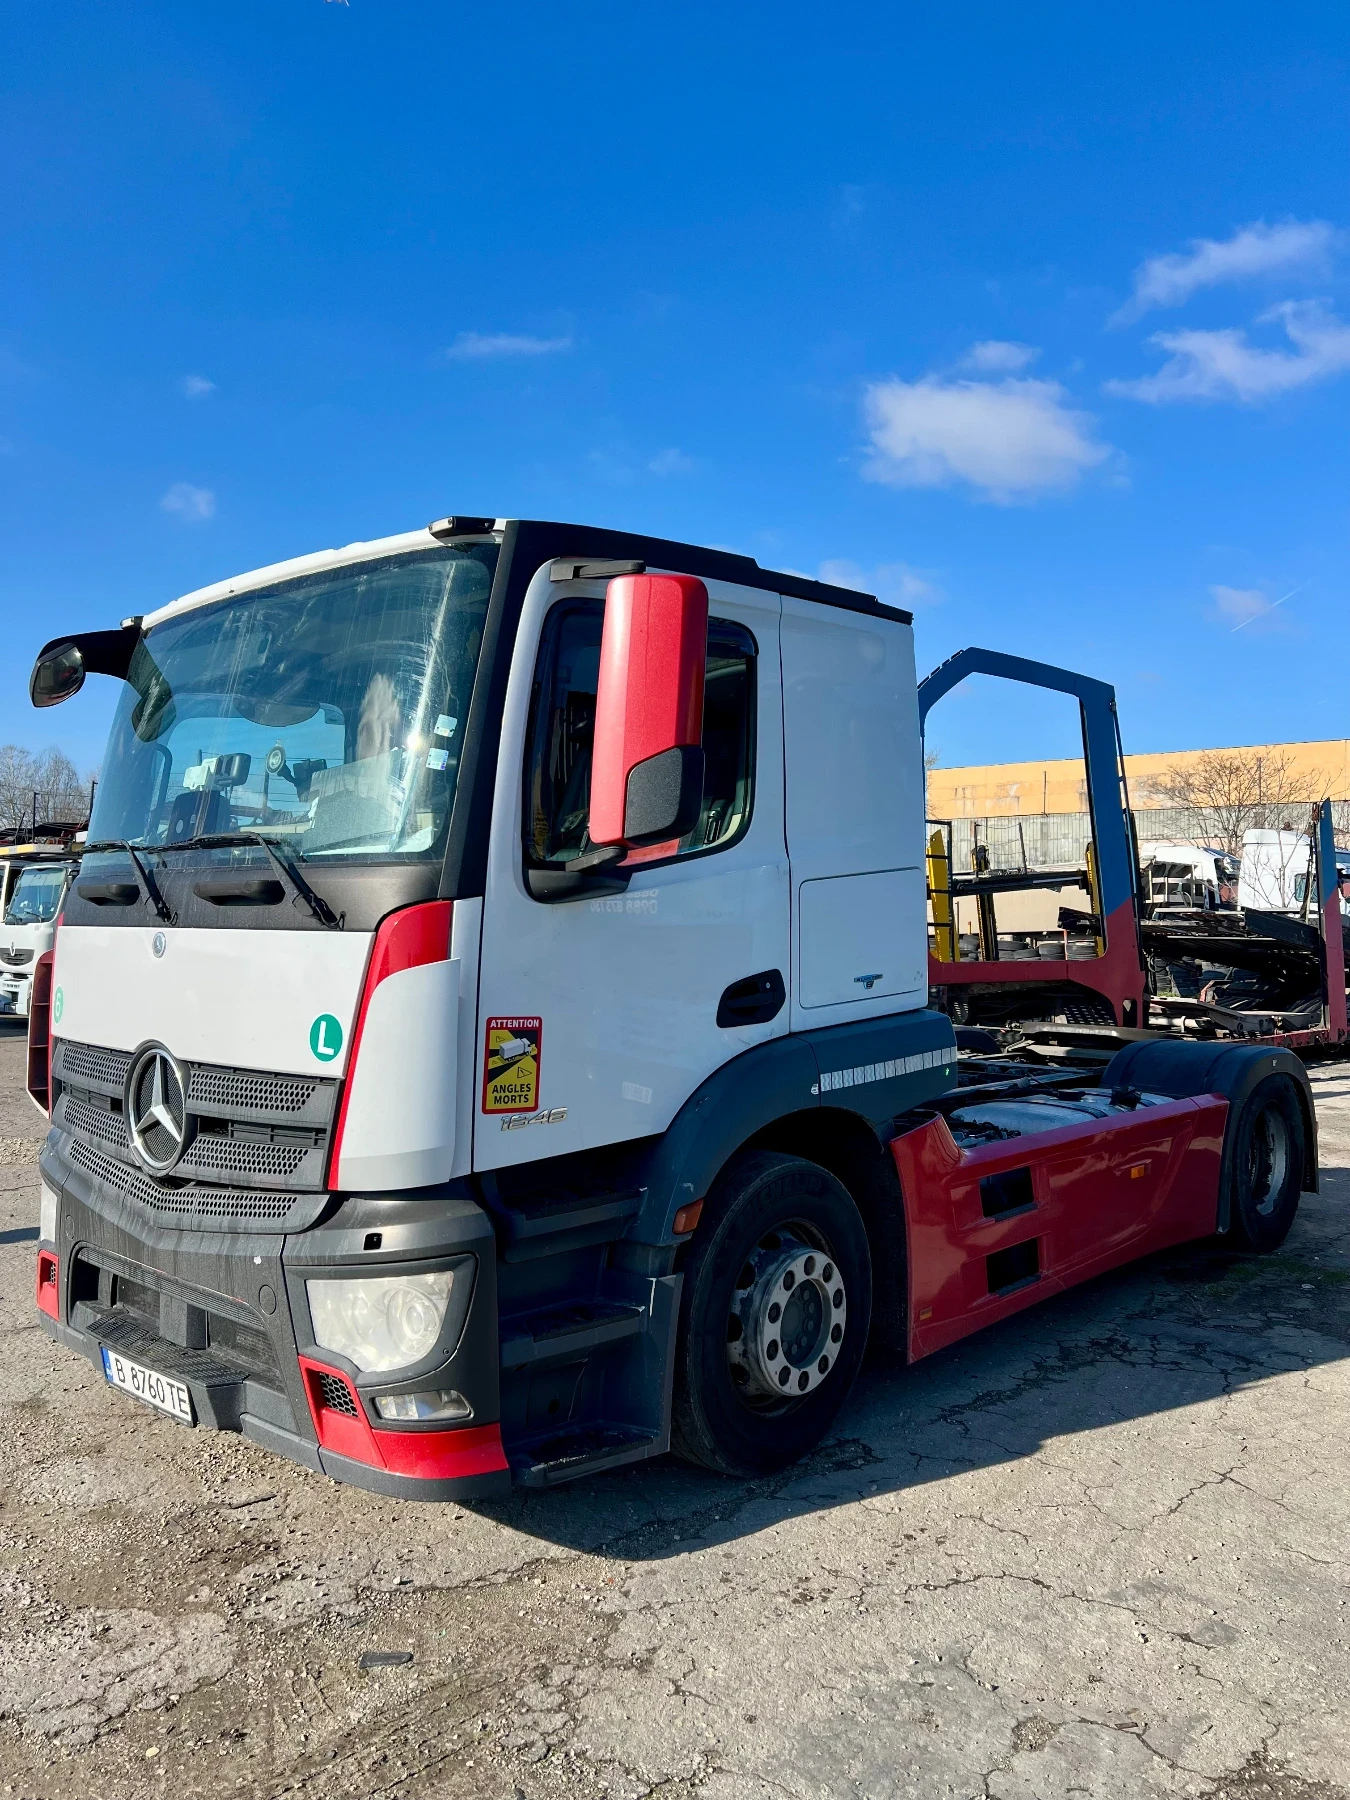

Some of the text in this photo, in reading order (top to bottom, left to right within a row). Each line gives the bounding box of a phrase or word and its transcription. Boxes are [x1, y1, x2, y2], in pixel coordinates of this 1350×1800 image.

[55, 992, 62, 1018] 6
[490, 1019, 539, 1028] ATTENTION
[317, 1020, 335, 1056] L
[492, 1083, 532, 1094] ANGLES
[493, 1094, 529, 1105] MORTS
[115, 1357, 126, 1384] B
[130, 1366, 166, 1404] 8760
[166, 1380, 190, 1416] TE
